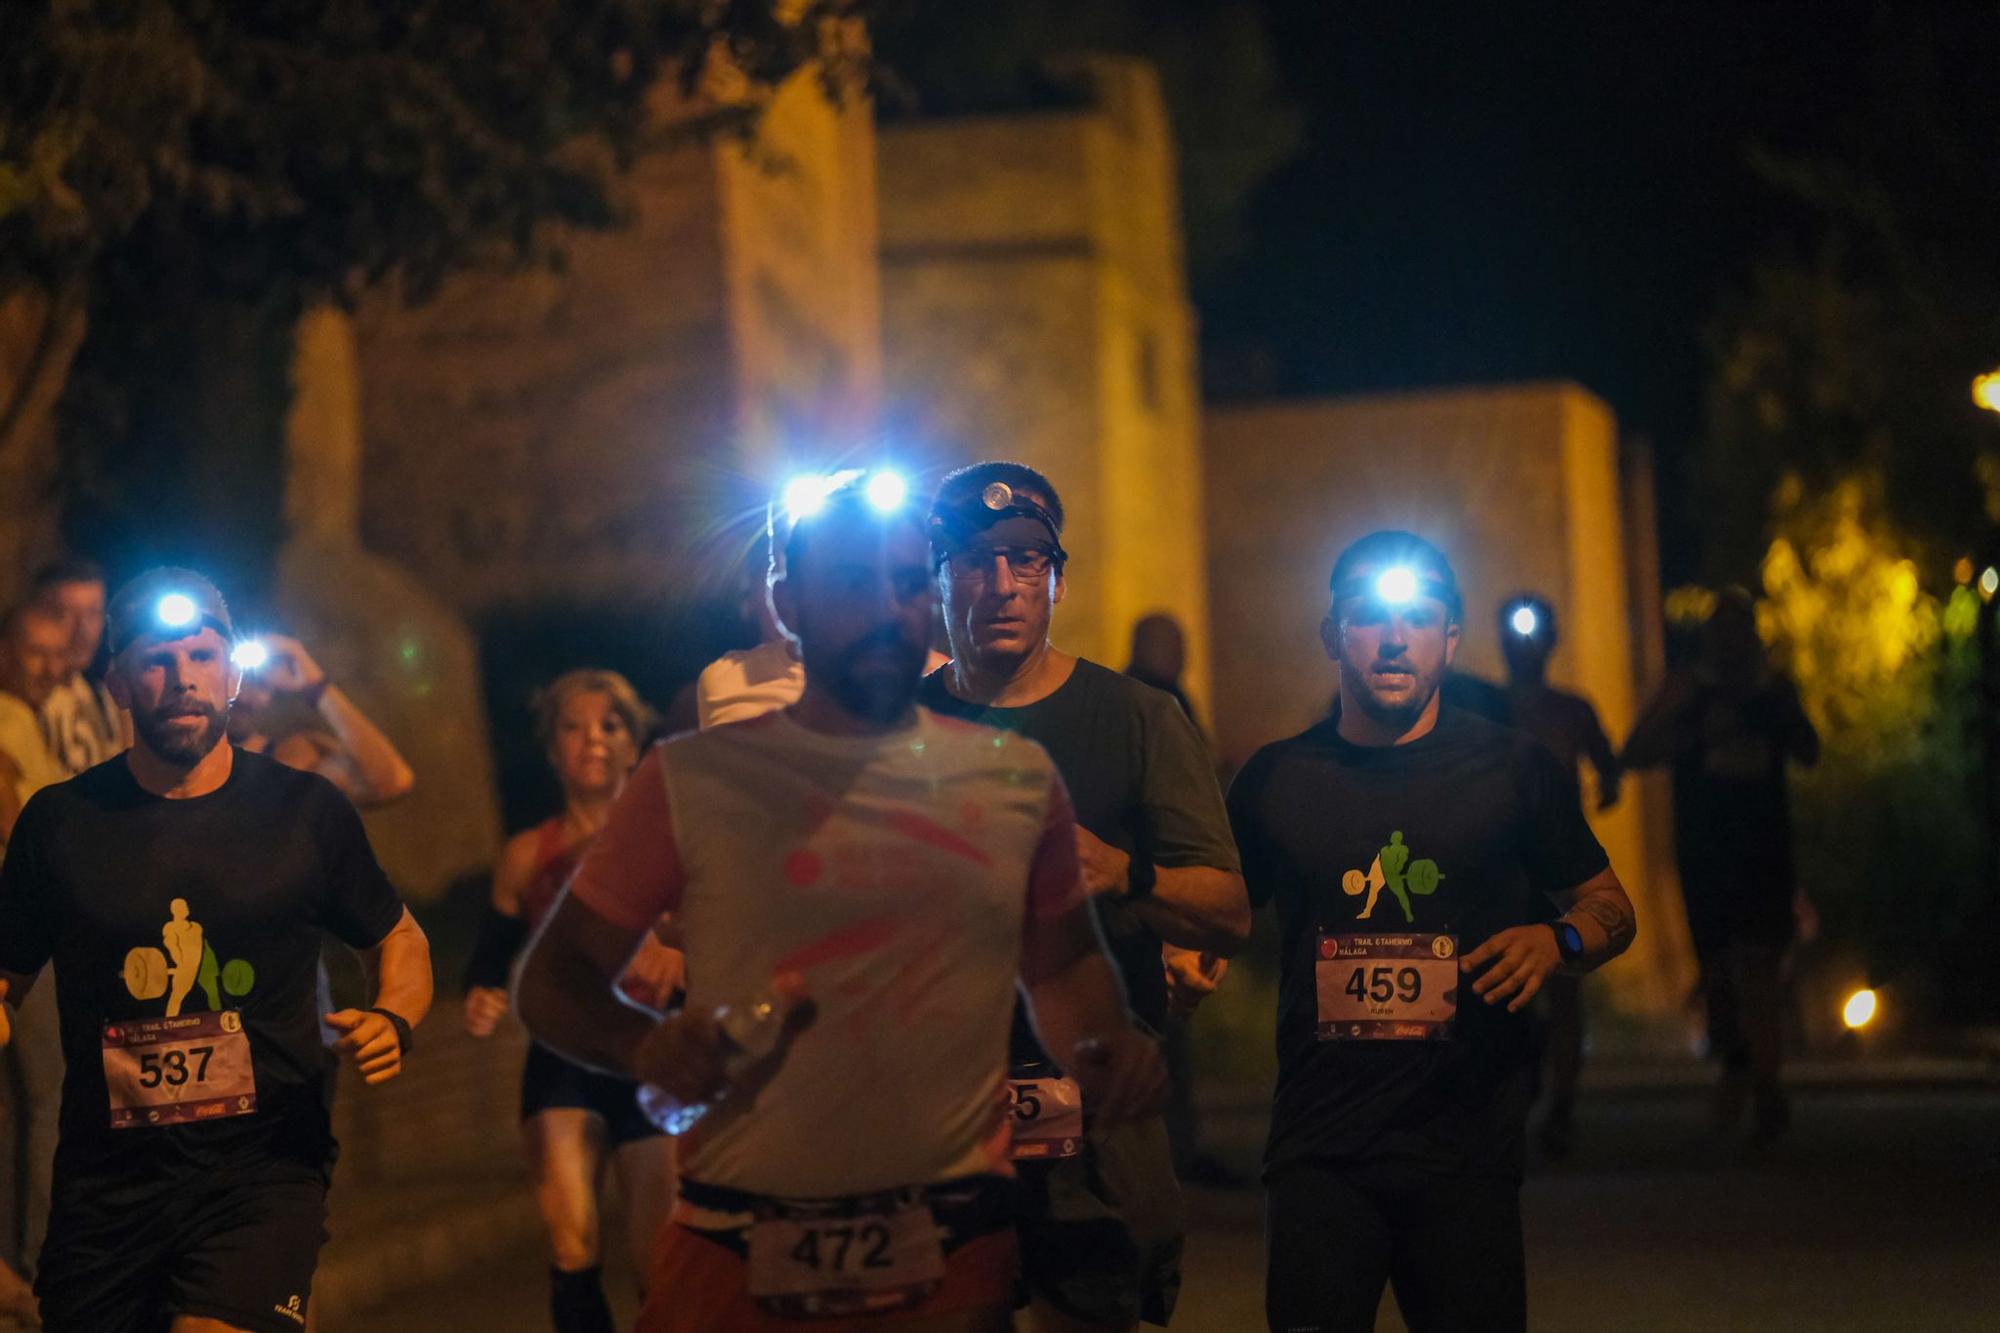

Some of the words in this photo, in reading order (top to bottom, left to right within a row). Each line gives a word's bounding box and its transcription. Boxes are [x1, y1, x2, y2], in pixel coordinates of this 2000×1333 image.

[1354, 938, 1374, 946] TRAIL
[1345, 967, 1421, 1003] 459
[139, 1046, 213, 1088] 537
[1010, 1085, 1040, 1120] 5
[791, 1222, 894, 1271] 472
